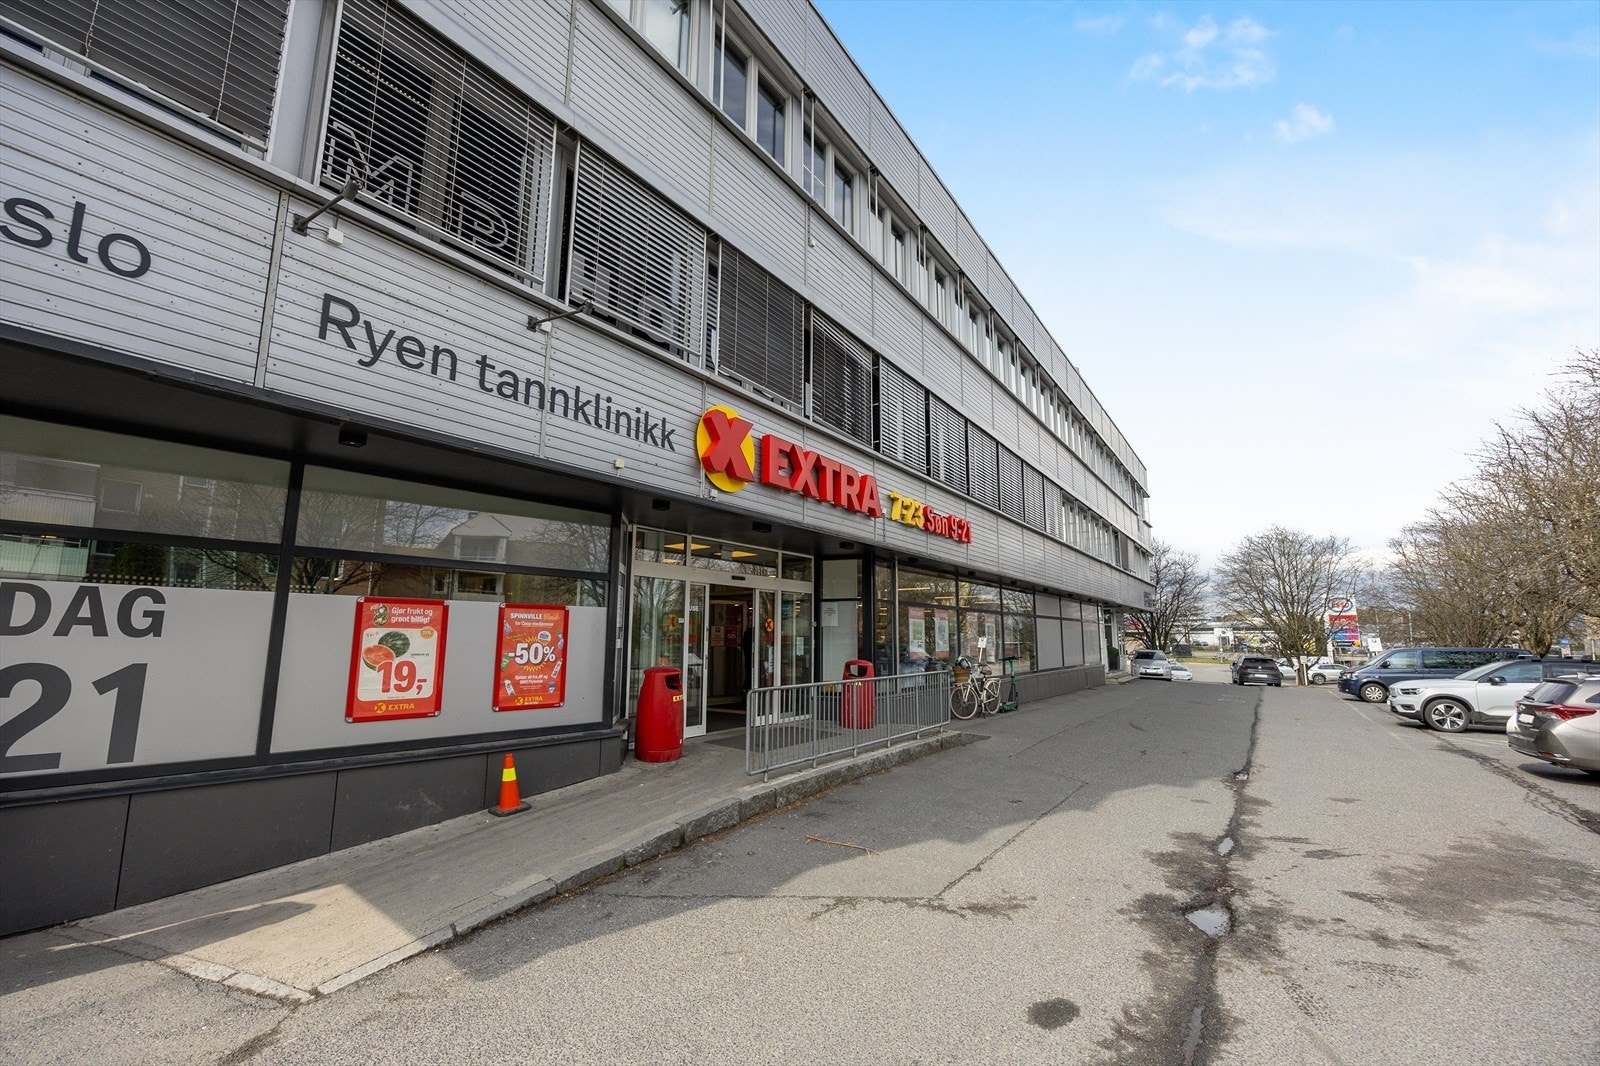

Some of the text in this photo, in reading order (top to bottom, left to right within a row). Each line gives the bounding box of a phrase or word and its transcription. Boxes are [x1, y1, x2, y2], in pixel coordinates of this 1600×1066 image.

[318, 293, 458, 382] Ryen
[475, 354, 677, 452] tannklinikk
[761, 433, 883, 518] EXTRA
[889, 492, 971, 543] 7-23 Søn 9-21
[0, 582, 167, 638] DAG
[392, 607, 405, 616] Gjør
[407, 607, 424, 616] frukt
[508, 642, 556, 664] -50%
